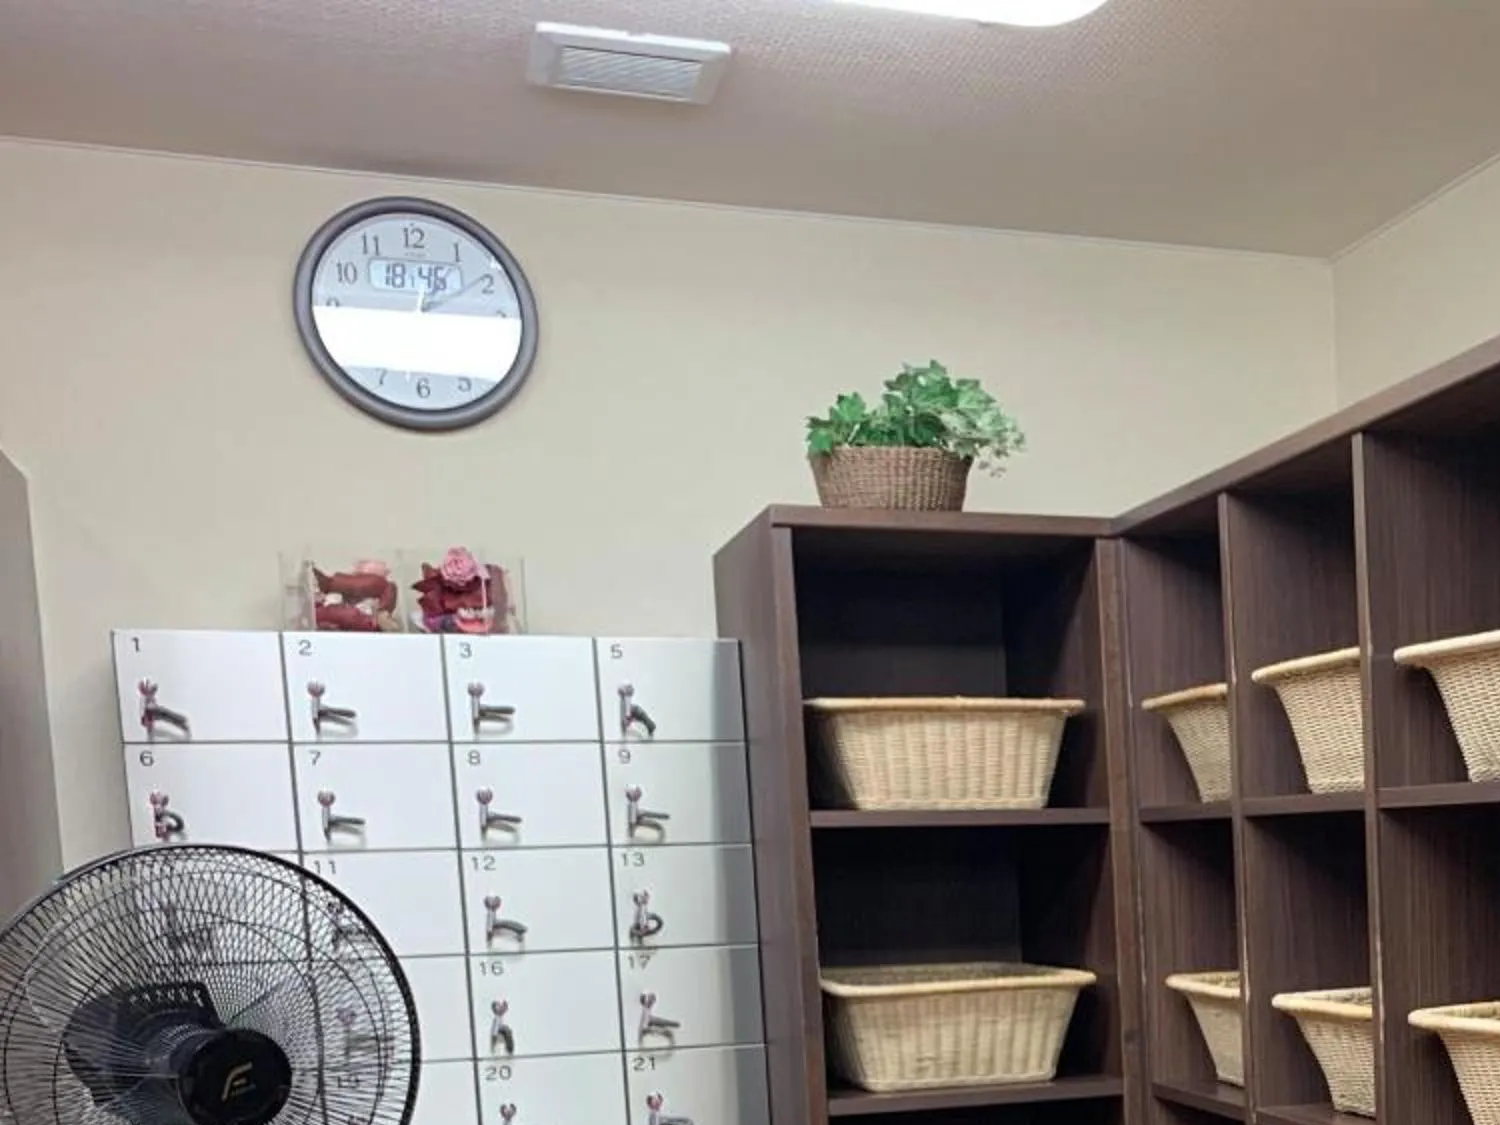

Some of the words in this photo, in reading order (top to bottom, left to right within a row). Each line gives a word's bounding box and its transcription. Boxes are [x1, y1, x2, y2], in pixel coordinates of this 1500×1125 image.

[361, 231, 381, 256] 11
[403, 227, 425, 249] 12
[453, 242, 461, 263] 1
[336, 261, 358, 284] 10
[481, 273, 495, 294] 2
[416, 377, 431, 399] 6
[131, 636, 142, 653] 1
[298, 639, 312, 656] 2
[459, 643, 473, 659] 3
[610, 643, 623, 660] 5
[139, 750, 154, 767] 6
[310, 750, 321, 767] 7
[467, 750, 481, 766] 8
[618, 748, 631, 764] 9
[471, 855, 497, 872] 12
[621, 852, 646, 868] 13
[479, 960, 504, 976] 16
[628, 954, 651, 970] 17
[633, 1056, 657, 1071] 21
[485, 1064, 512, 1081] 20
